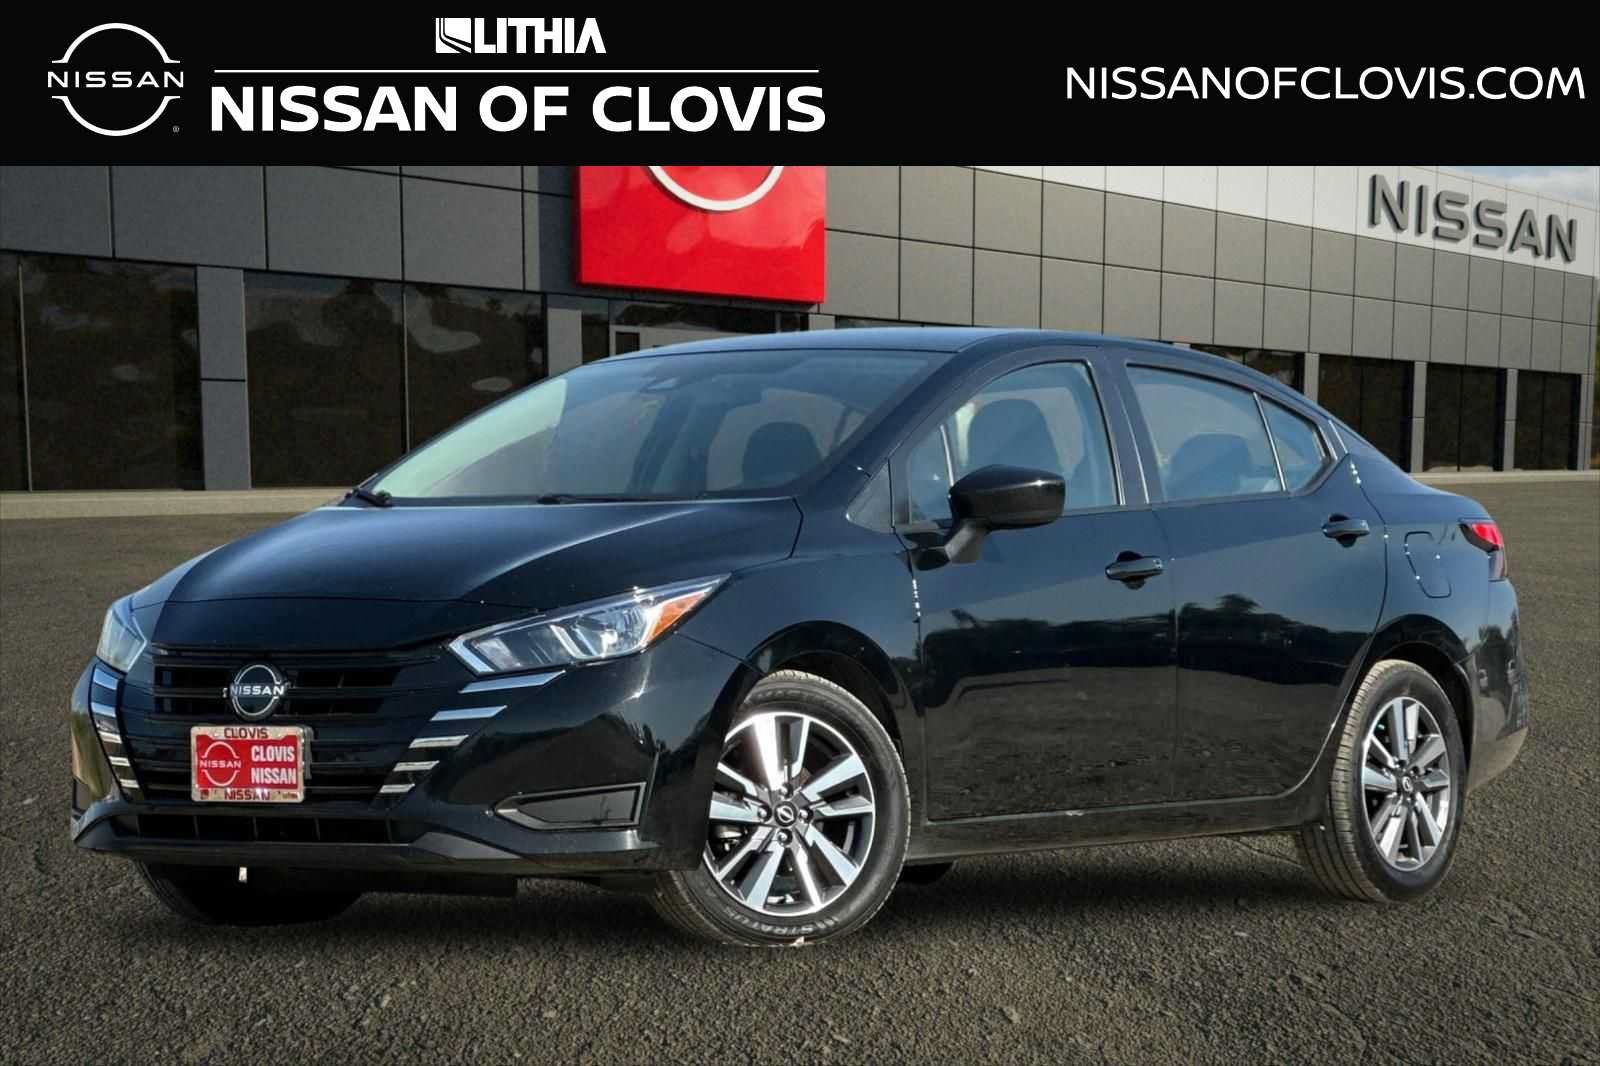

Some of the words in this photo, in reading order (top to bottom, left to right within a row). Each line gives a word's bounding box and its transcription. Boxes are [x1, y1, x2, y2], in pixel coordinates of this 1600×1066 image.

[1368, 174, 1577, 263] NISSAN
[230, 684, 285, 696] NISSAN
[224, 727, 269, 739] CLOVIS
[251, 745, 296, 762] CLOVIS
[200, 760, 242, 769] NISSAN
[251, 767, 297, 785] NISSAN
[224, 789, 271, 801] NISSAN
